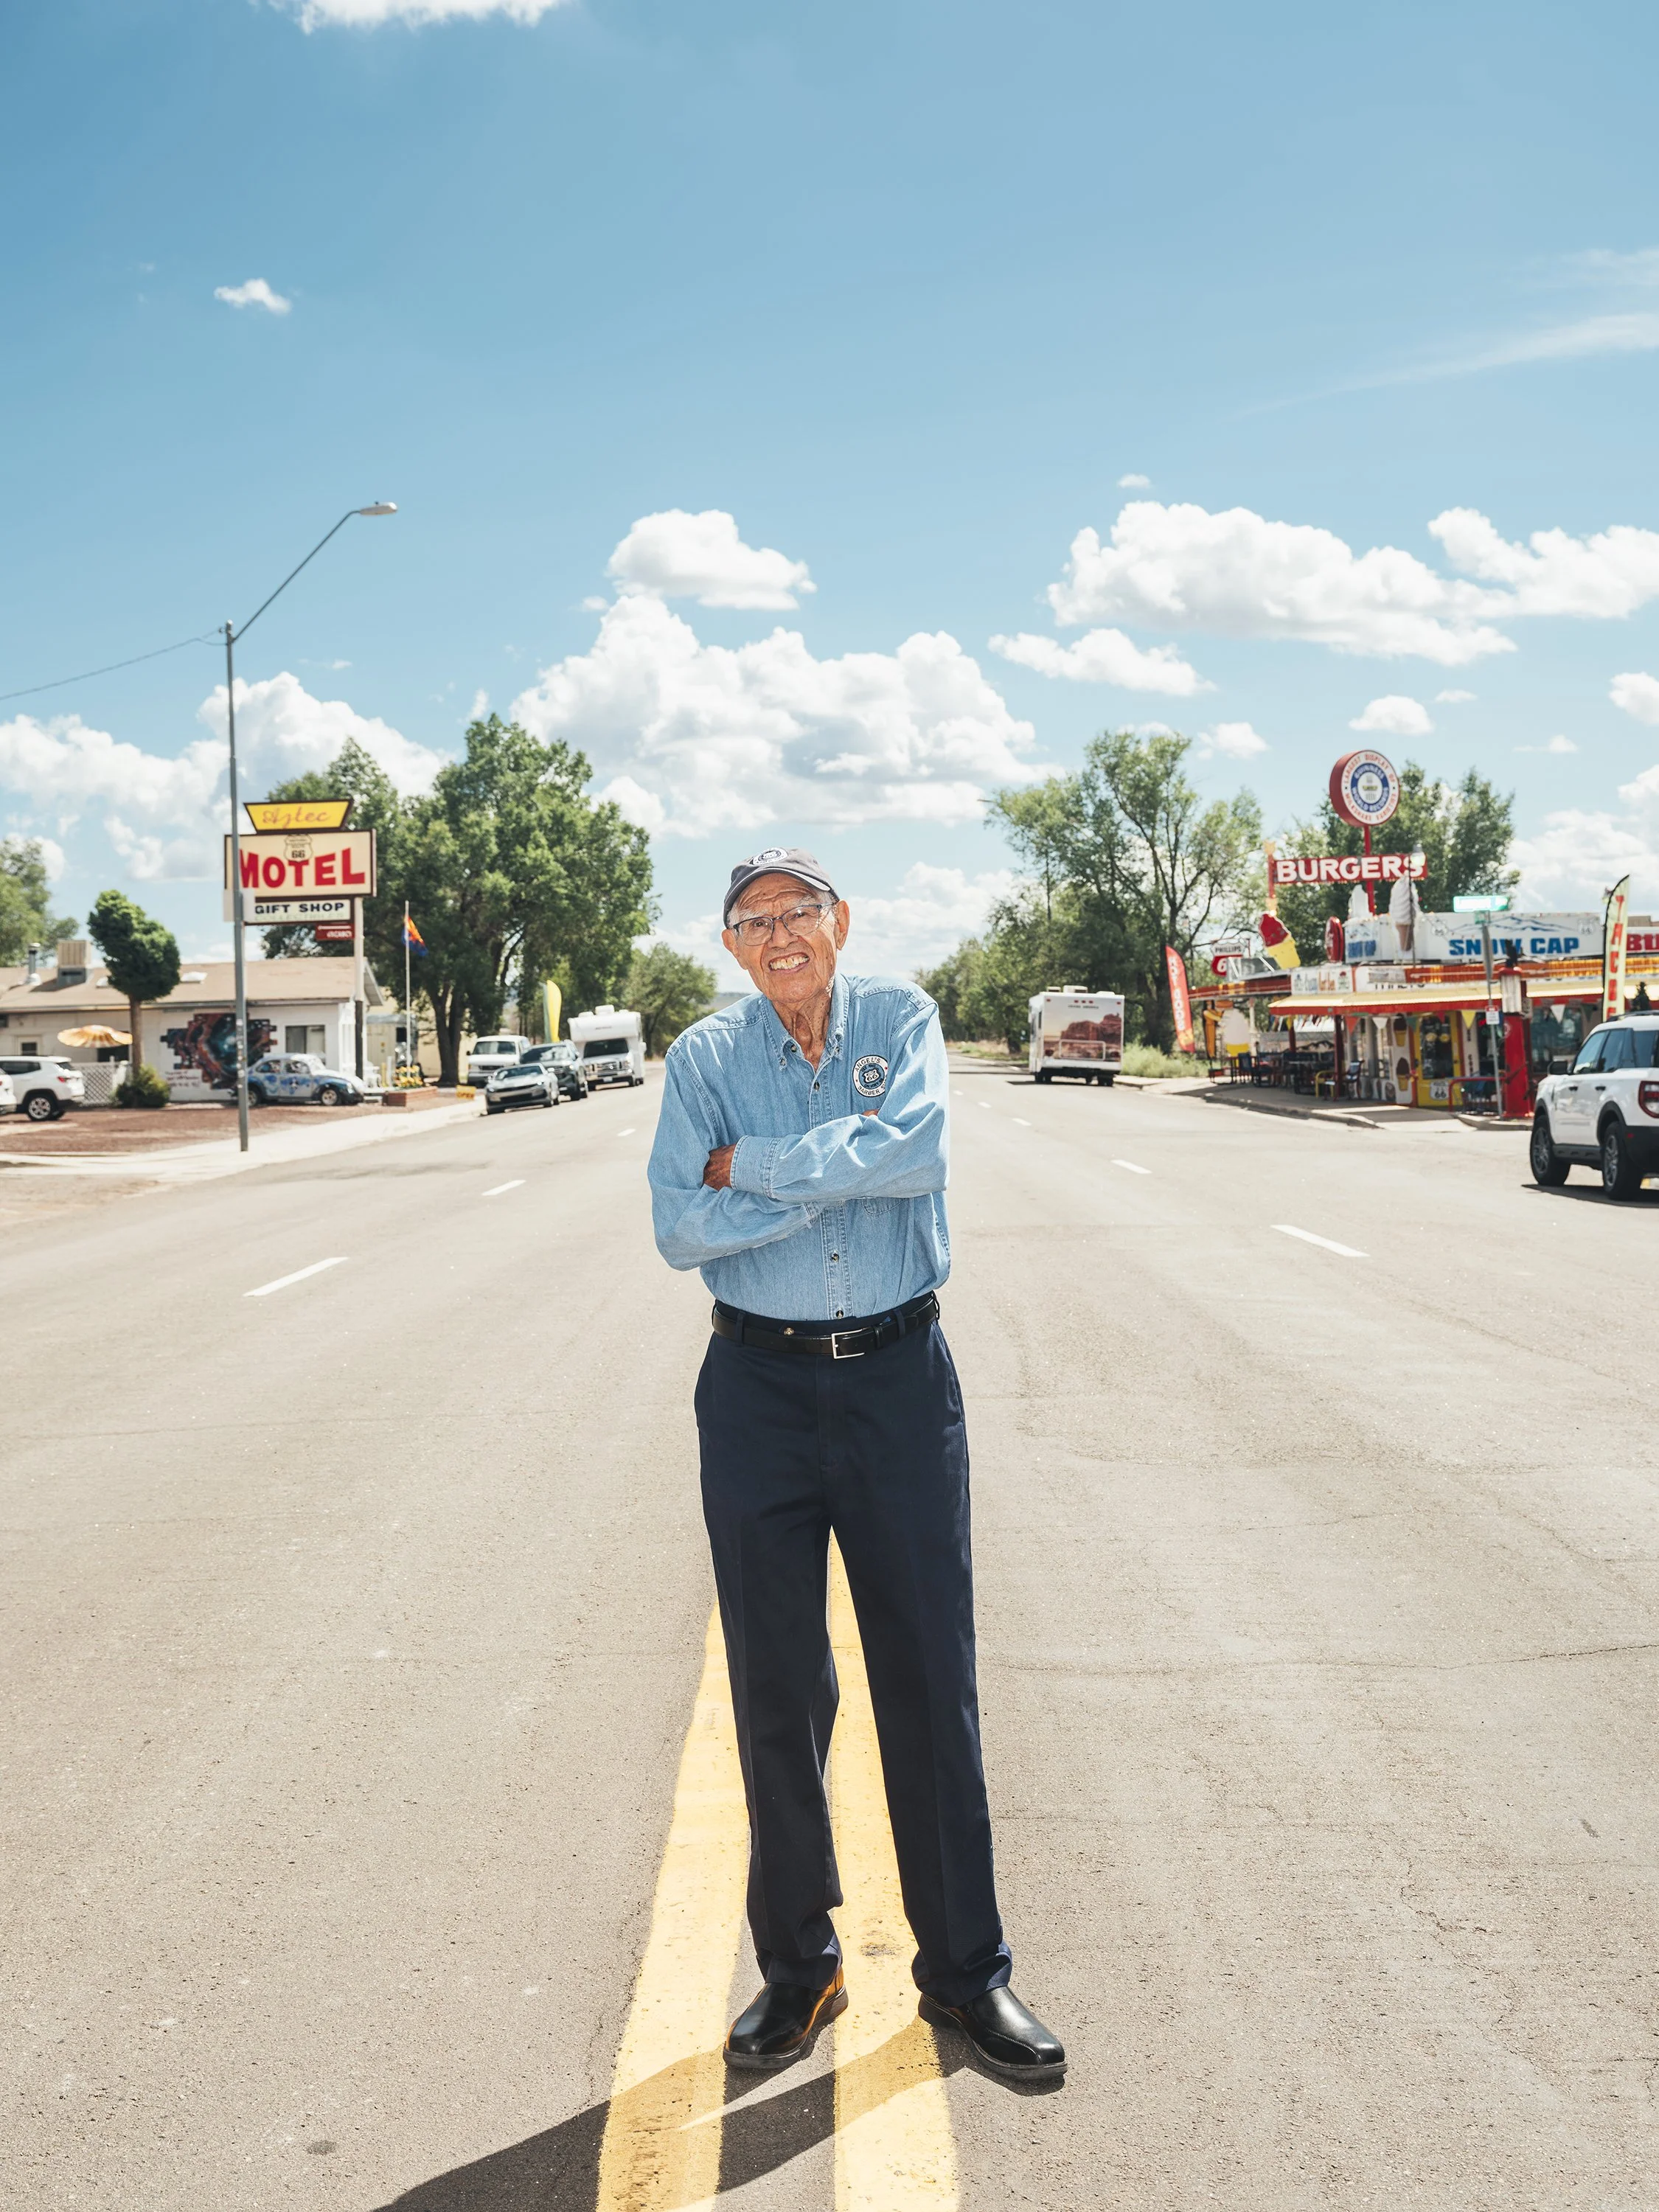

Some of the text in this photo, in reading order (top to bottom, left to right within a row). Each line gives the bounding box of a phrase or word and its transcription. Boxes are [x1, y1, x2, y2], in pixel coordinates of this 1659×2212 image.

[262, 807, 330, 829] Aztec
[292, 850, 305, 858] 66
[240, 848, 365, 888] MOTEL
[1276, 855, 1424, 883] BURGERS
[255, 902, 344, 914] GIFT SHOP
[1530, 937, 1579, 954] CAP
[1217, 959, 1227, 973] 6
[855, 1057, 880, 1072] ANGEL'S
[858, 1085, 880, 1095] BARBER
